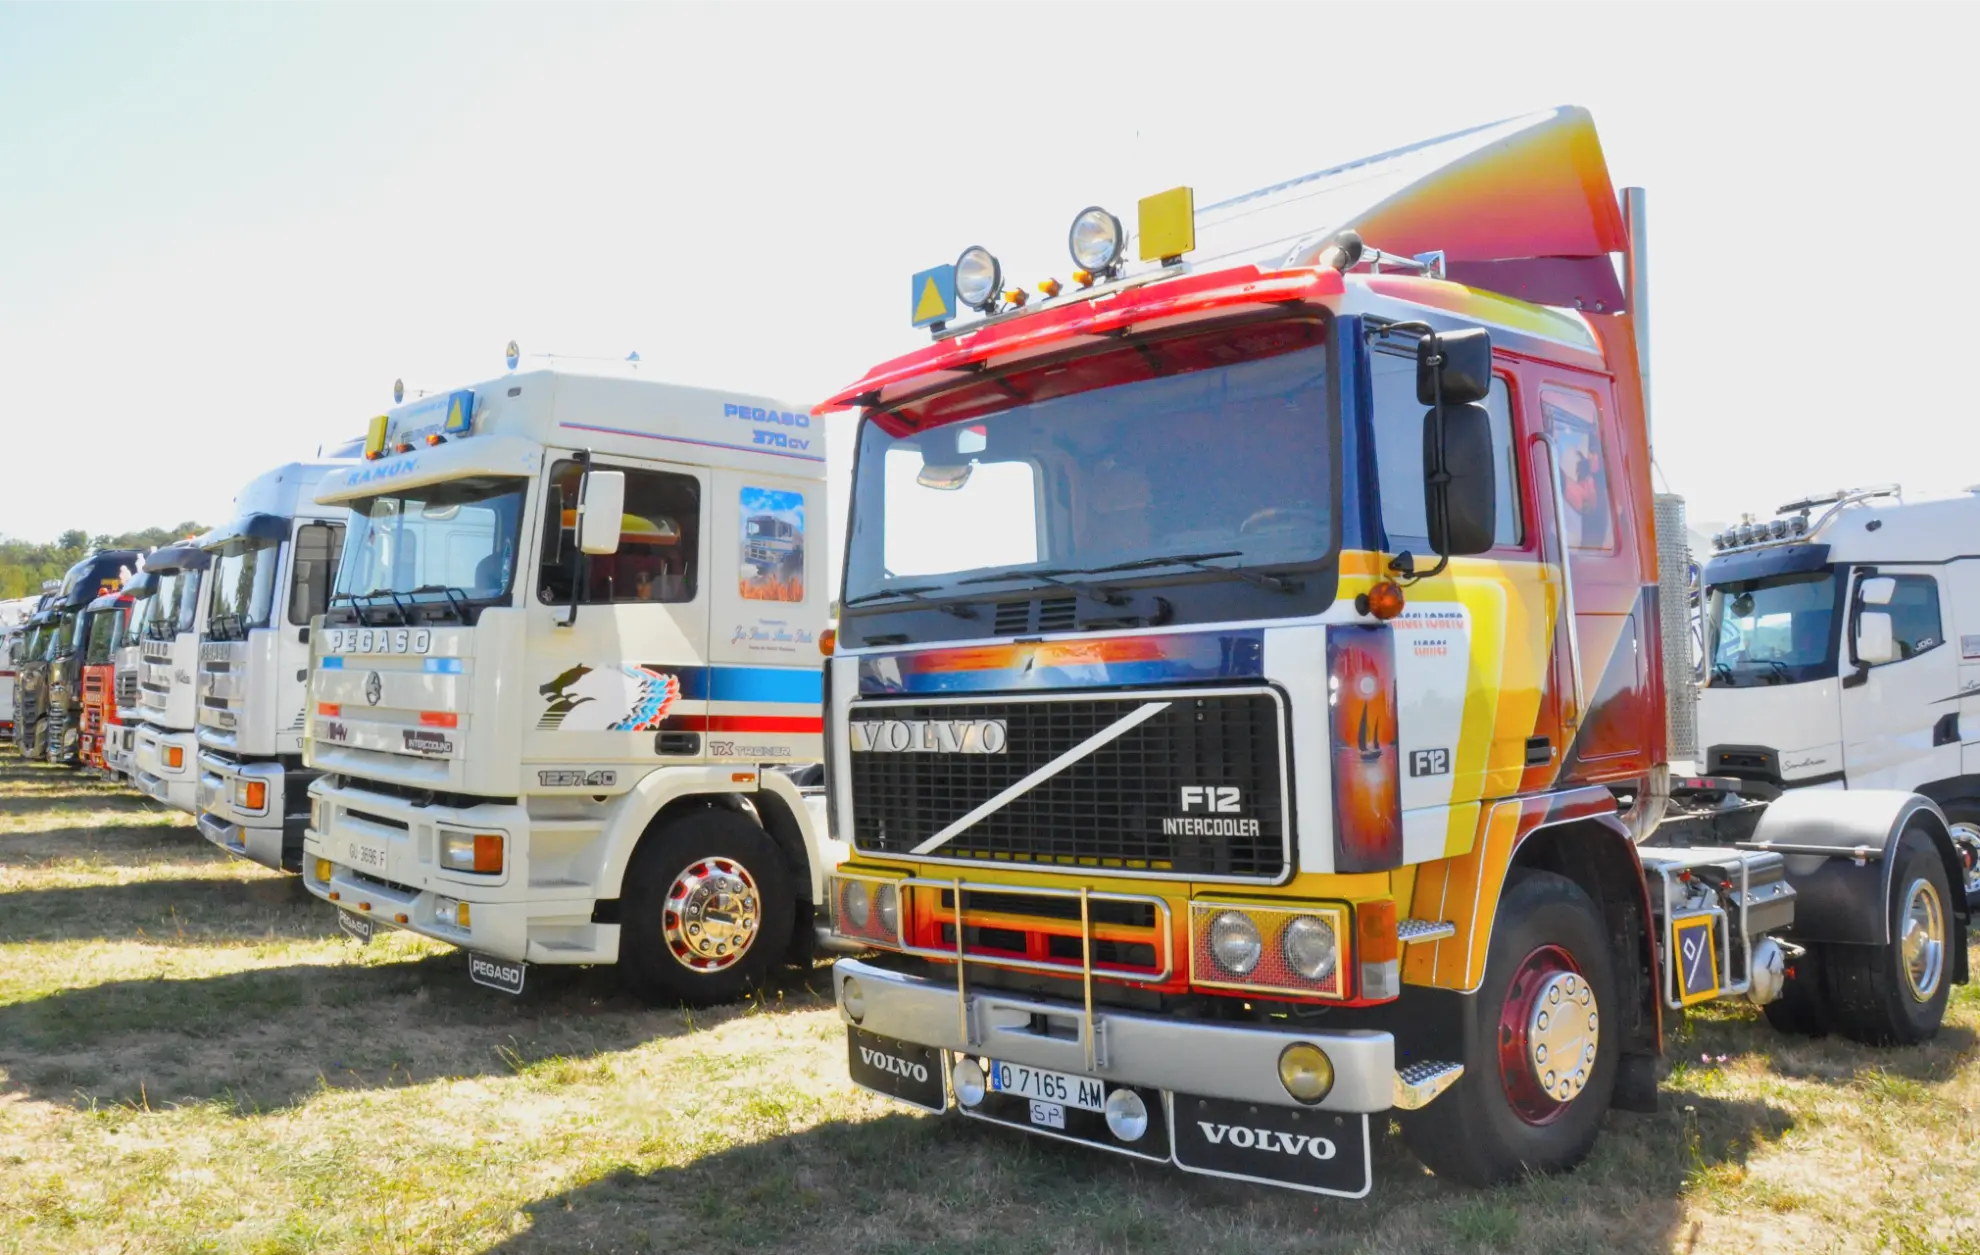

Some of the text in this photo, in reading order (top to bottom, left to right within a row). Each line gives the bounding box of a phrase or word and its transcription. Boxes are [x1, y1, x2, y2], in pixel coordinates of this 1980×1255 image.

[723, 404, 810, 428] PEGASO
[331, 629, 431, 654] PEGASO
[709, 742, 734, 756] TX
[852, 720, 1006, 753] VOLVO
[1416, 750, 1447, 775] F12
[537, 770, 617, 787] 1237.40
[1181, 786, 1241, 812] F12
[1163, 818, 1260, 837] INTERCOOLER
[339, 910, 370, 936] PEGASO
[472, 960, 519, 983] PEGASO
[859, 1046, 928, 1083] VOLVO
[1019, 1068, 1068, 1100] 7165
[1078, 1080, 1102, 1109] AM
[1197, 1121, 1337, 1161] VOLVO
